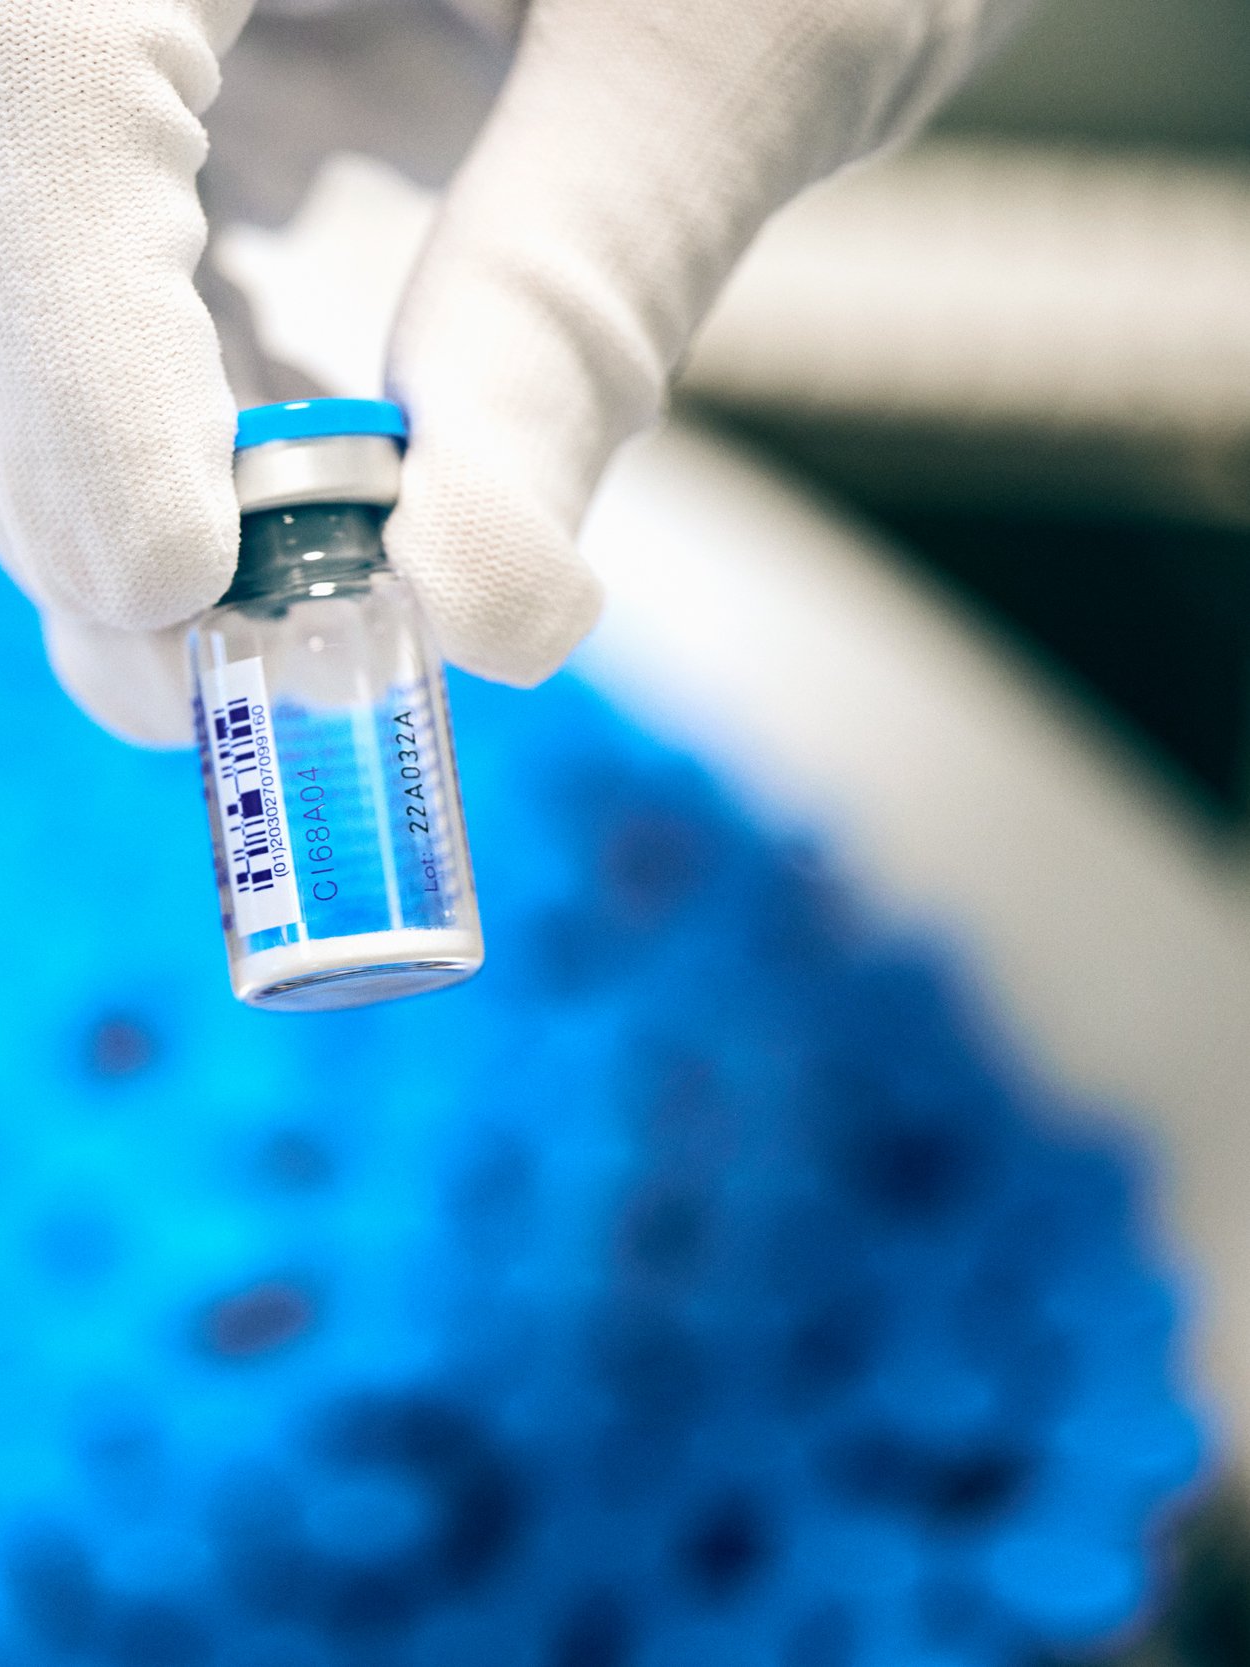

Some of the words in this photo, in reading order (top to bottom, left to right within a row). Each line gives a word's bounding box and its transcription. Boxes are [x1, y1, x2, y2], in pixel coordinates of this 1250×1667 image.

[251, 704, 290, 878] (01)20302707099160
[393, 711, 429, 833] 22A032A
[421, 851, 439, 892] Lot:
